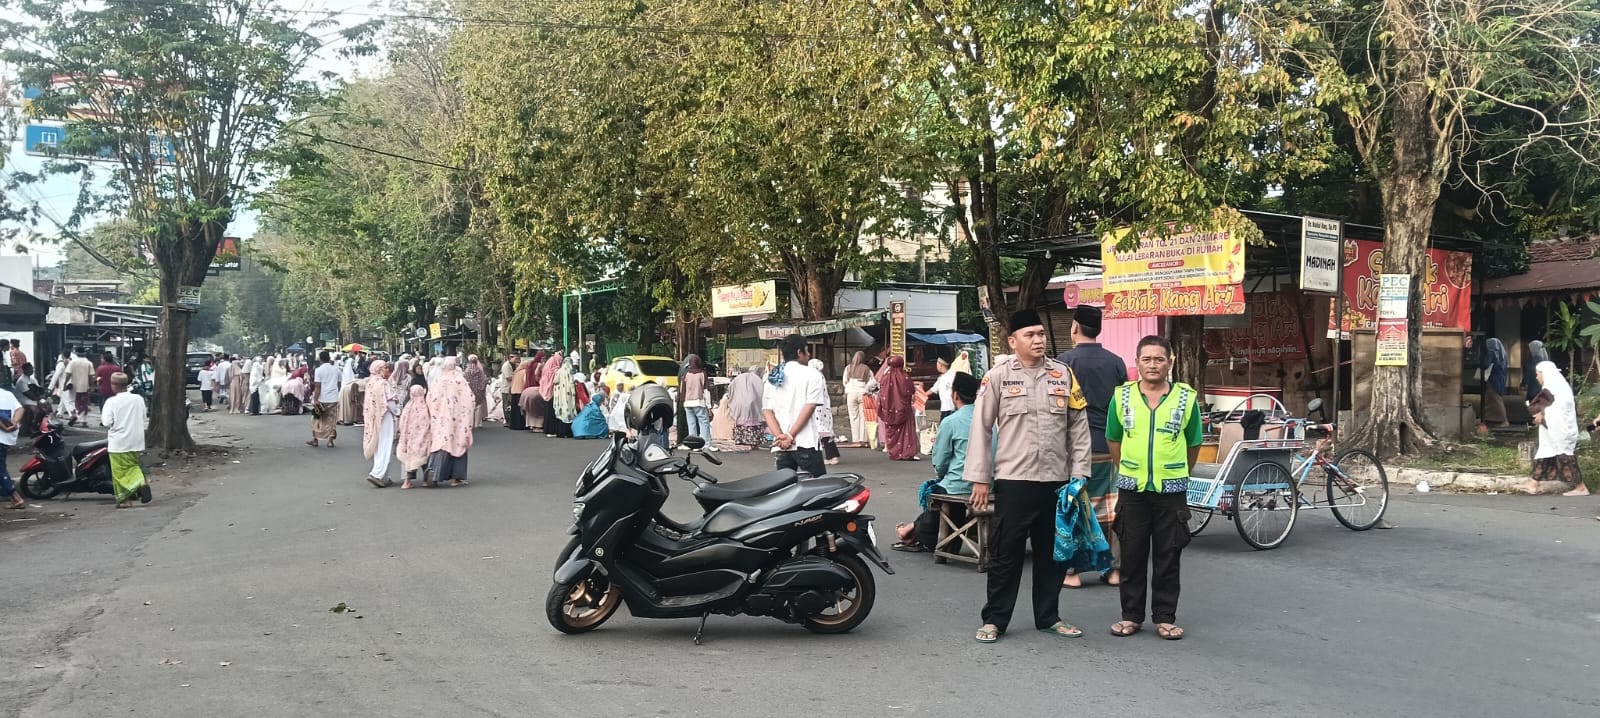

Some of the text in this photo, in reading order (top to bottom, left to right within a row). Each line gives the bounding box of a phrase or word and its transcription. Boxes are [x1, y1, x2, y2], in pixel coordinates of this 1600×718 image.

[1179, 236, 1196, 245] DAN
[1166, 248, 1185, 258] BUKA
[1186, 247, 1195, 256] DI
[1196, 244, 1223, 254] RUMAH
[1305, 255, 1336, 272] MADINAH
[1382, 276, 1408, 287] PEC
[179, 287, 200, 296] PEC
[1160, 287, 1201, 313] Kang
[1202, 283, 1234, 310] Ari
